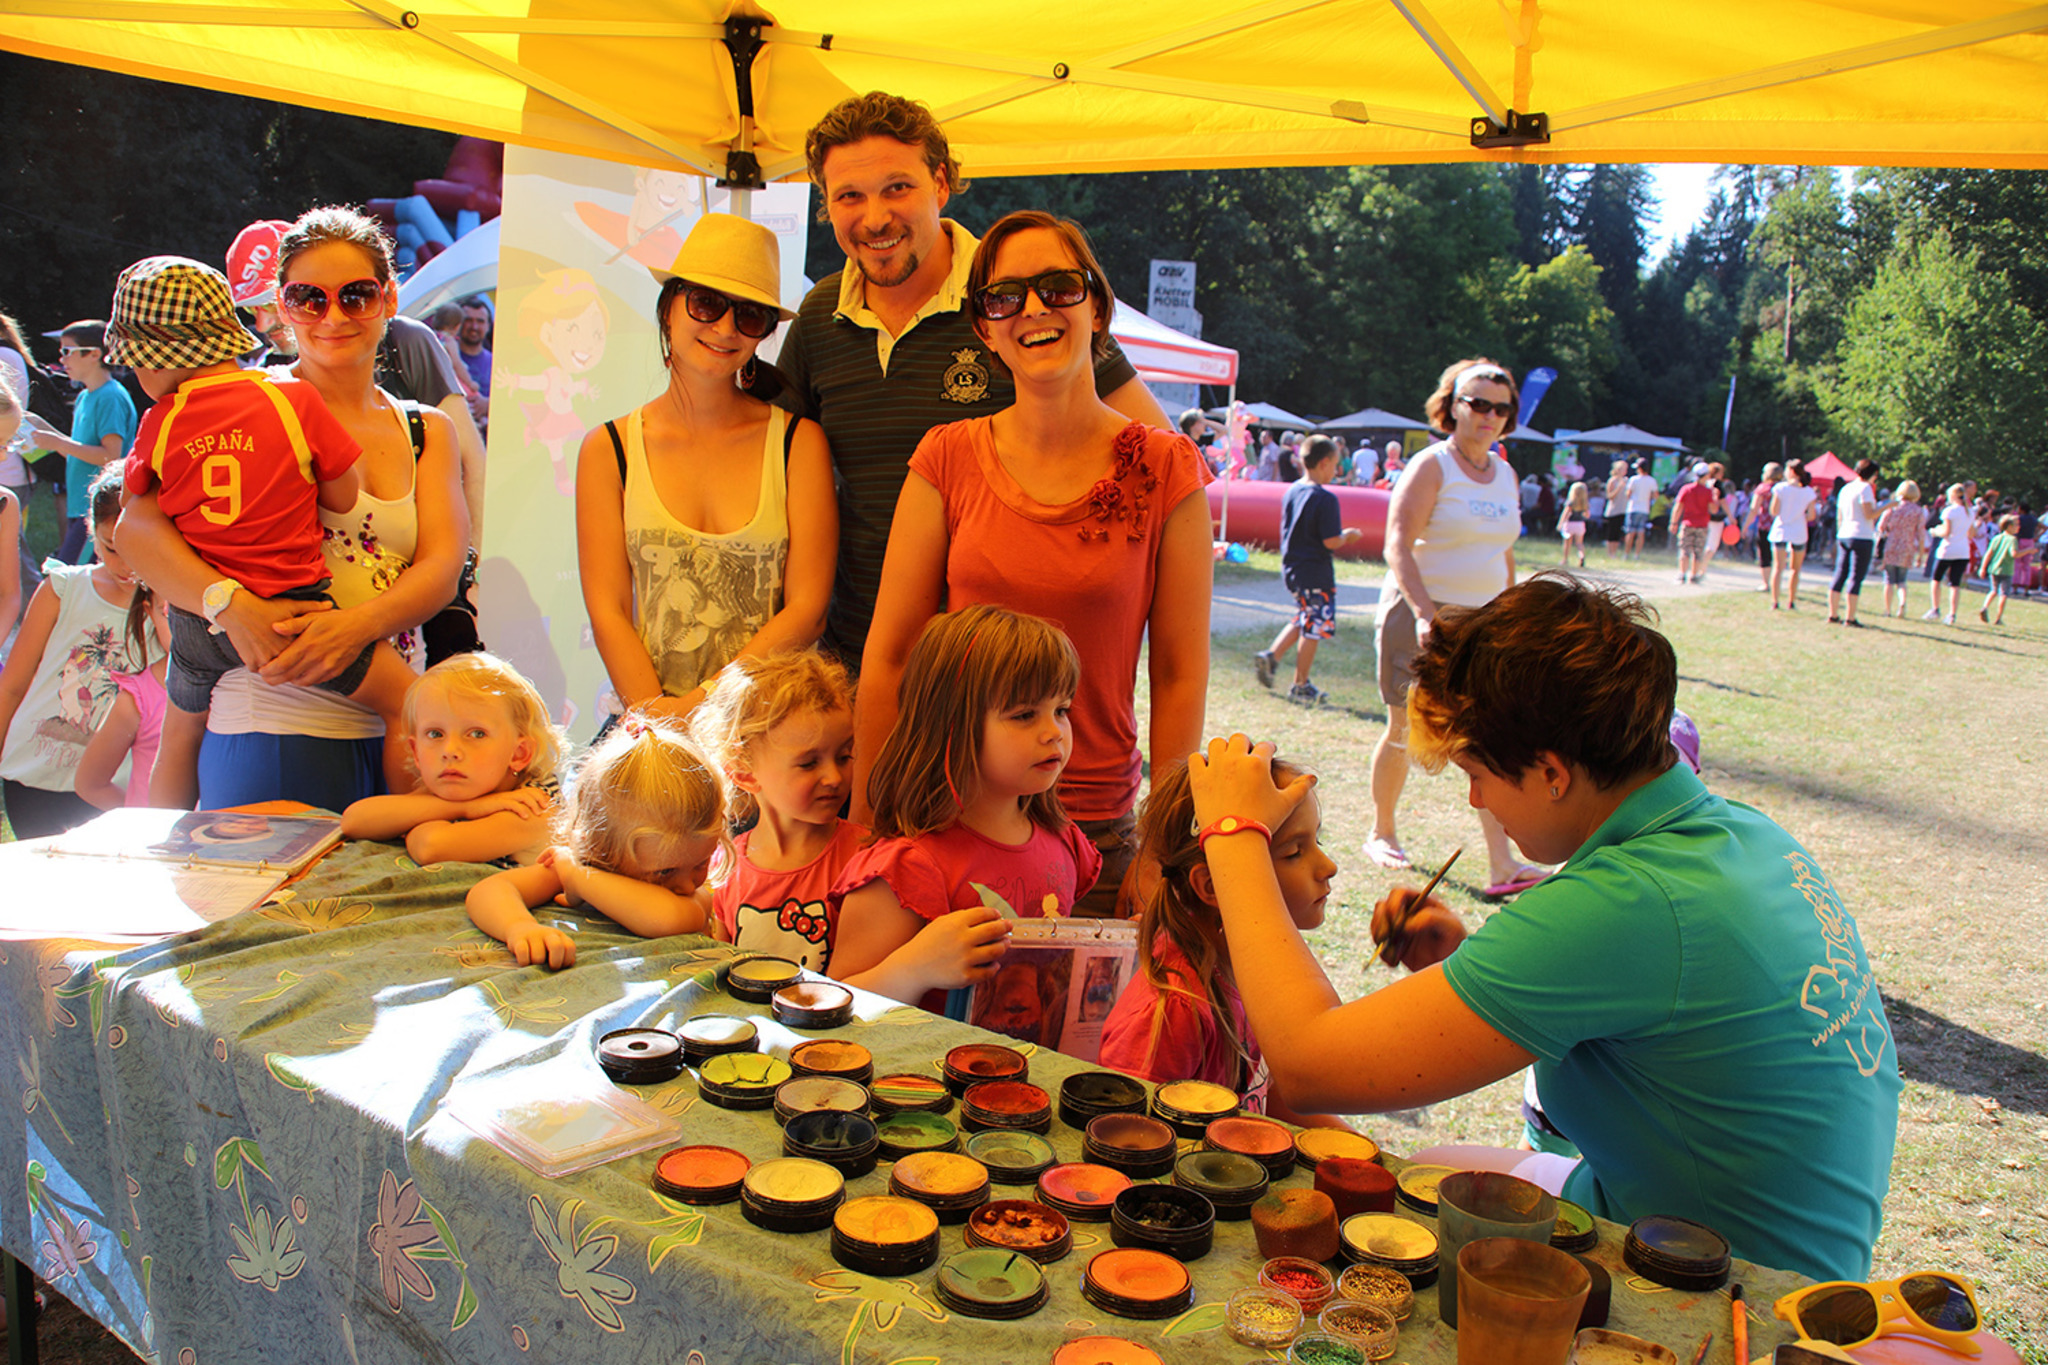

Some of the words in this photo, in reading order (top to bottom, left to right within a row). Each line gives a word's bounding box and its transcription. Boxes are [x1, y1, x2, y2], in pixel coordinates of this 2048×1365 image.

[1153, 296, 1190, 308] MOBIL
[184, 429, 255, 460] ESPAÑA
[200, 454, 242, 526] 9
